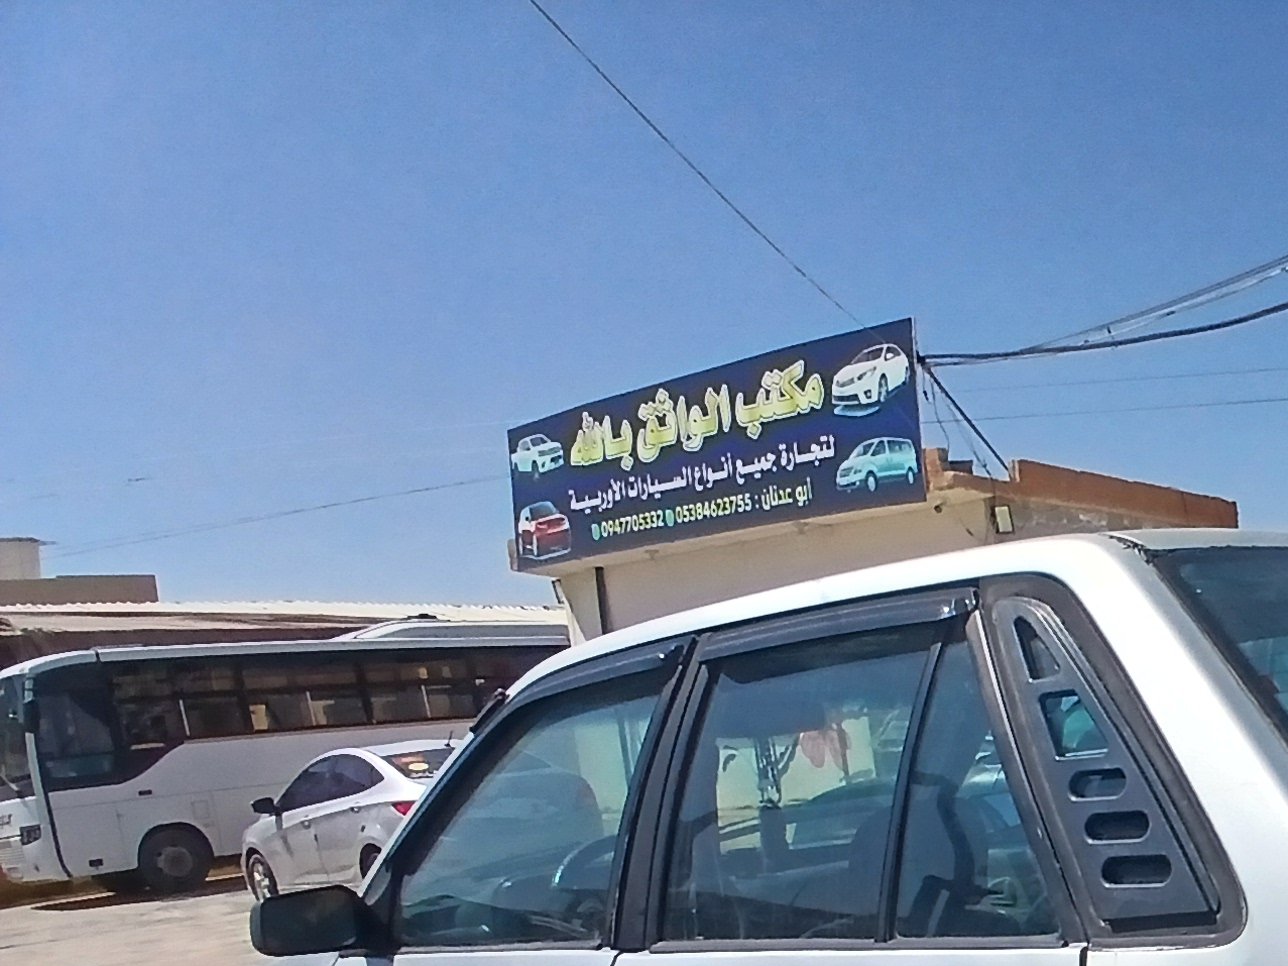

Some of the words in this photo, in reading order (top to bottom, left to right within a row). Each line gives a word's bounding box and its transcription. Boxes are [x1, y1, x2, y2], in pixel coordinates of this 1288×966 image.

[735, 359, 825, 440] مكتب
[570, 411, 633, 470] بالله
[637, 384, 732, 462] الواثق
[736, 452, 776, 485] جميع
[779, 434, 835, 471] لتجارة
[628, 466, 693, 501] السيارات
[761, 485, 793, 510] عدنان
[600, 510, 664, 537] 0947705332
[675, 493, 752, 523] 05384623755
